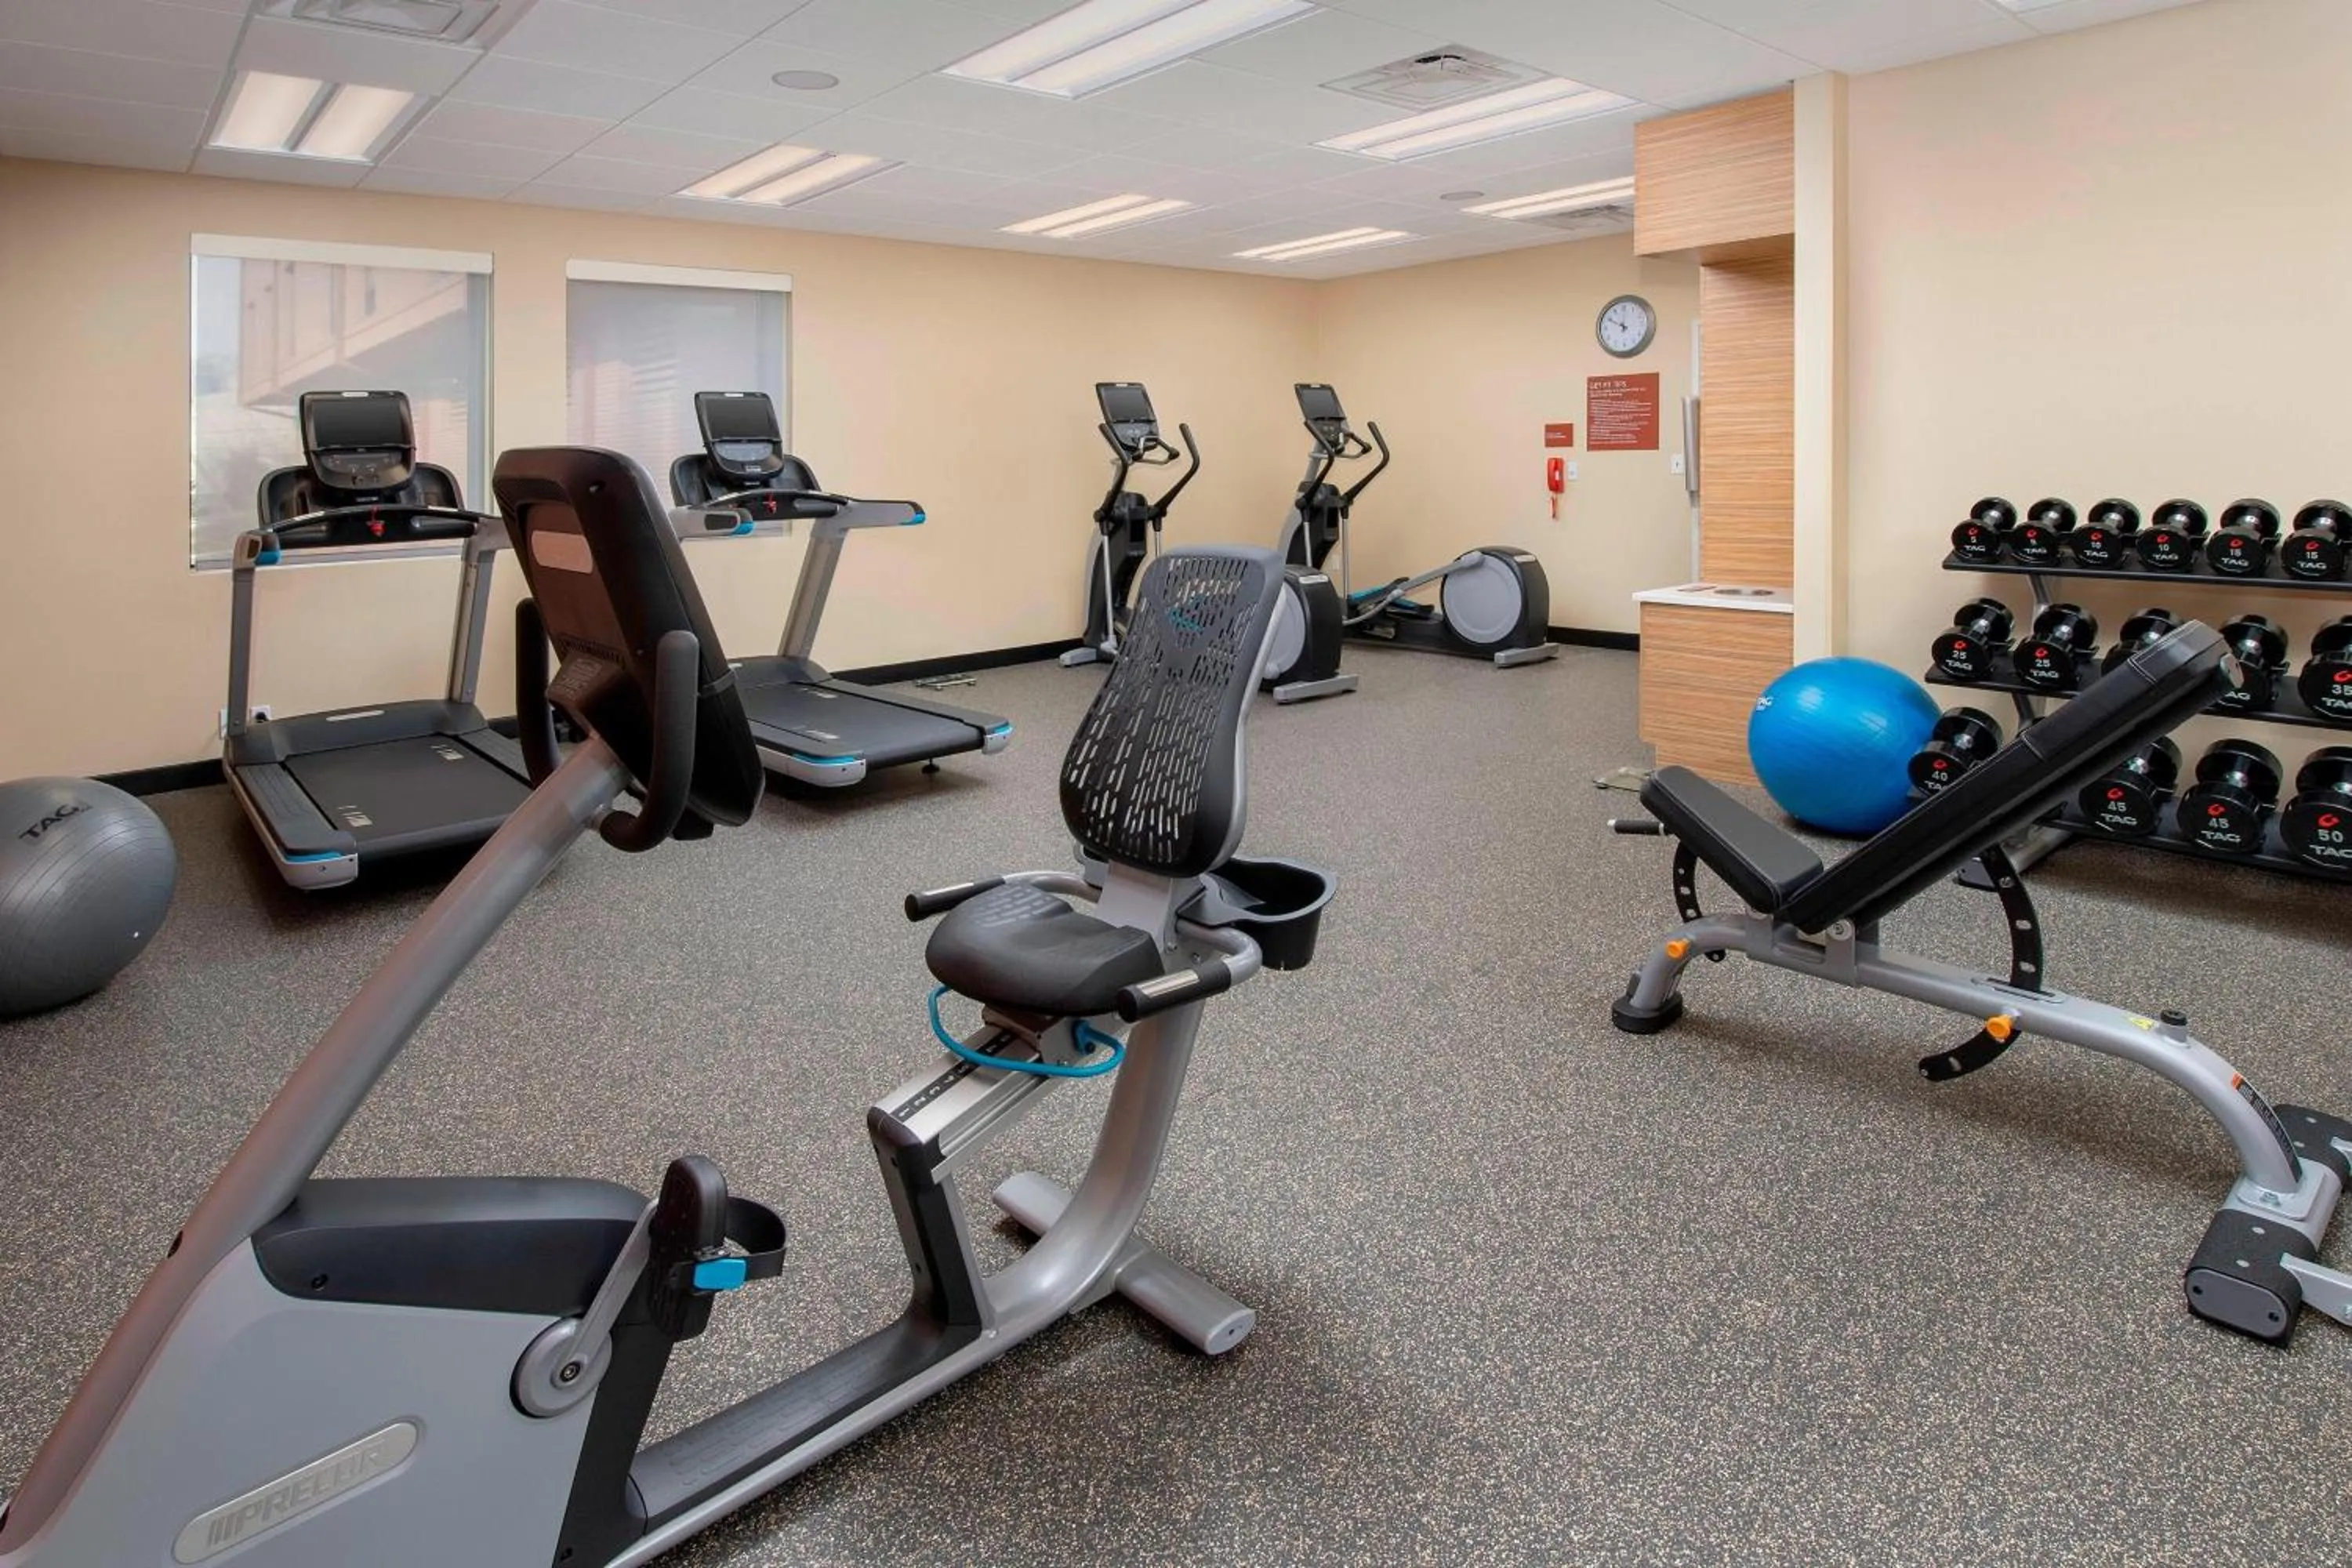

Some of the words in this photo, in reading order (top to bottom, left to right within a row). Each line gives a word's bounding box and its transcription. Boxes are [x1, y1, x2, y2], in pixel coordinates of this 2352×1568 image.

[2221, 557, 2249, 567] TAG
[2296, 561, 2327, 569] TAG
[1952, 650, 1967, 659] 25
[1945, 659, 1973, 671] TAG
[2034, 659, 2051, 667] 25
[2030, 669, 2060, 678] TAG
[2332, 684, 2352, 695] 35
[2224, 691, 2251, 700] AG
[1931, 770, 1948, 782] 40
[2107, 800, 2127, 812] 45
[18, 804, 81, 840] TAG
[2100, 813, 2138, 826] TAG
[2208, 818, 2230, 829] 45
[2201, 830, 2241, 843] TAG
[2318, 829, 2343, 843] 50
